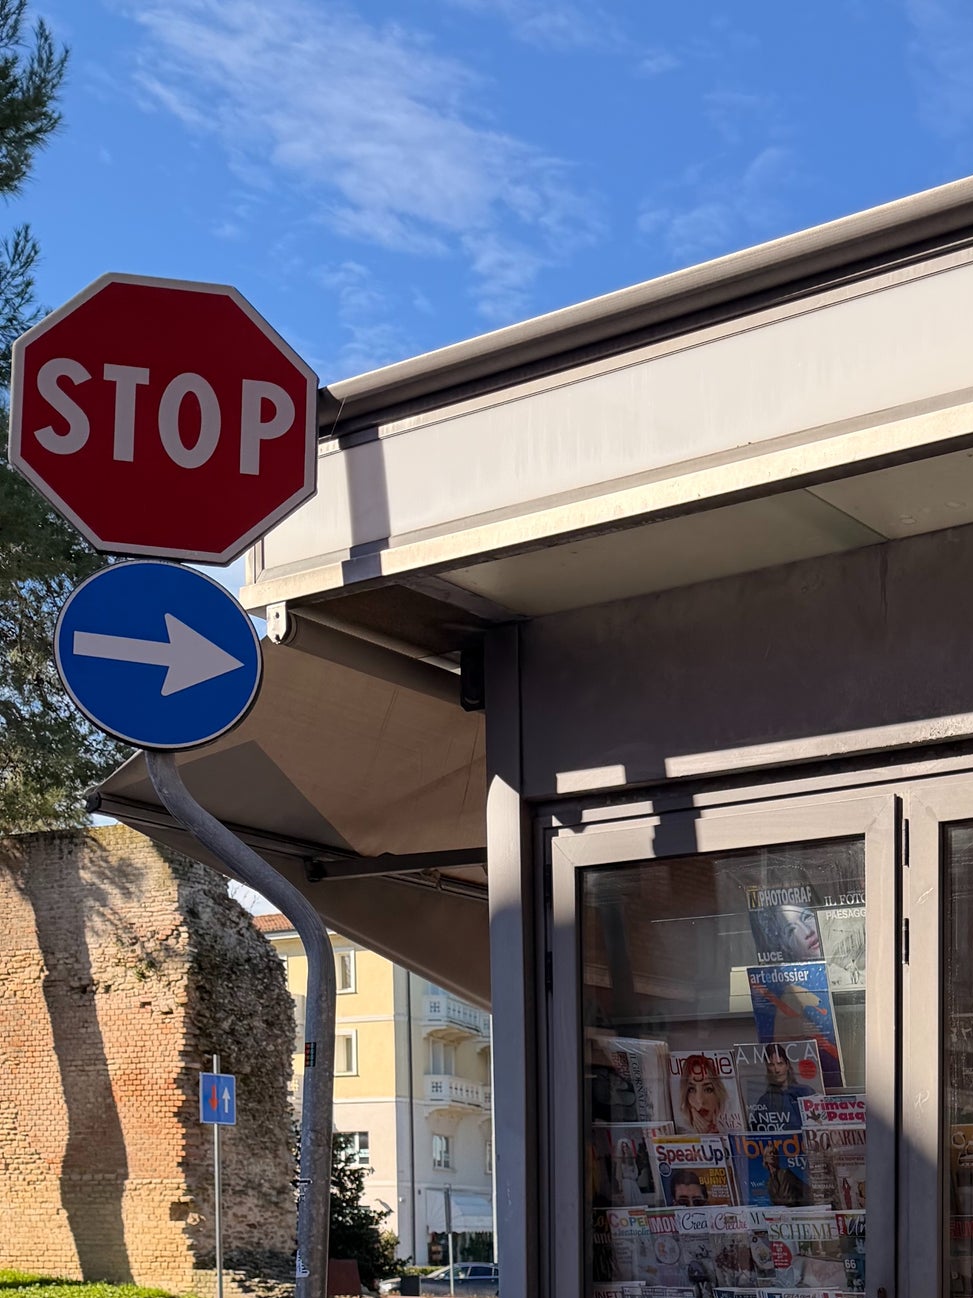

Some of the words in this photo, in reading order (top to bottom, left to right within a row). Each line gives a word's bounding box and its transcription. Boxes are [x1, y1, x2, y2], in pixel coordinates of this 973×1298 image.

[33, 358, 296, 475] STOP
[824, 896, 836, 906] IL
[758, 952, 783, 962] LUCE
[750, 969, 809, 983] artedossier
[736, 1044, 818, 1064] AMICA
[749, 1113, 757, 1124] A
[758, 1112, 790, 1122] NEW
[749, 1123, 785, 1131] LOOK
[656, 1145, 723, 1165] SpeakUp
[698, 1177, 726, 1185] BUNNY
